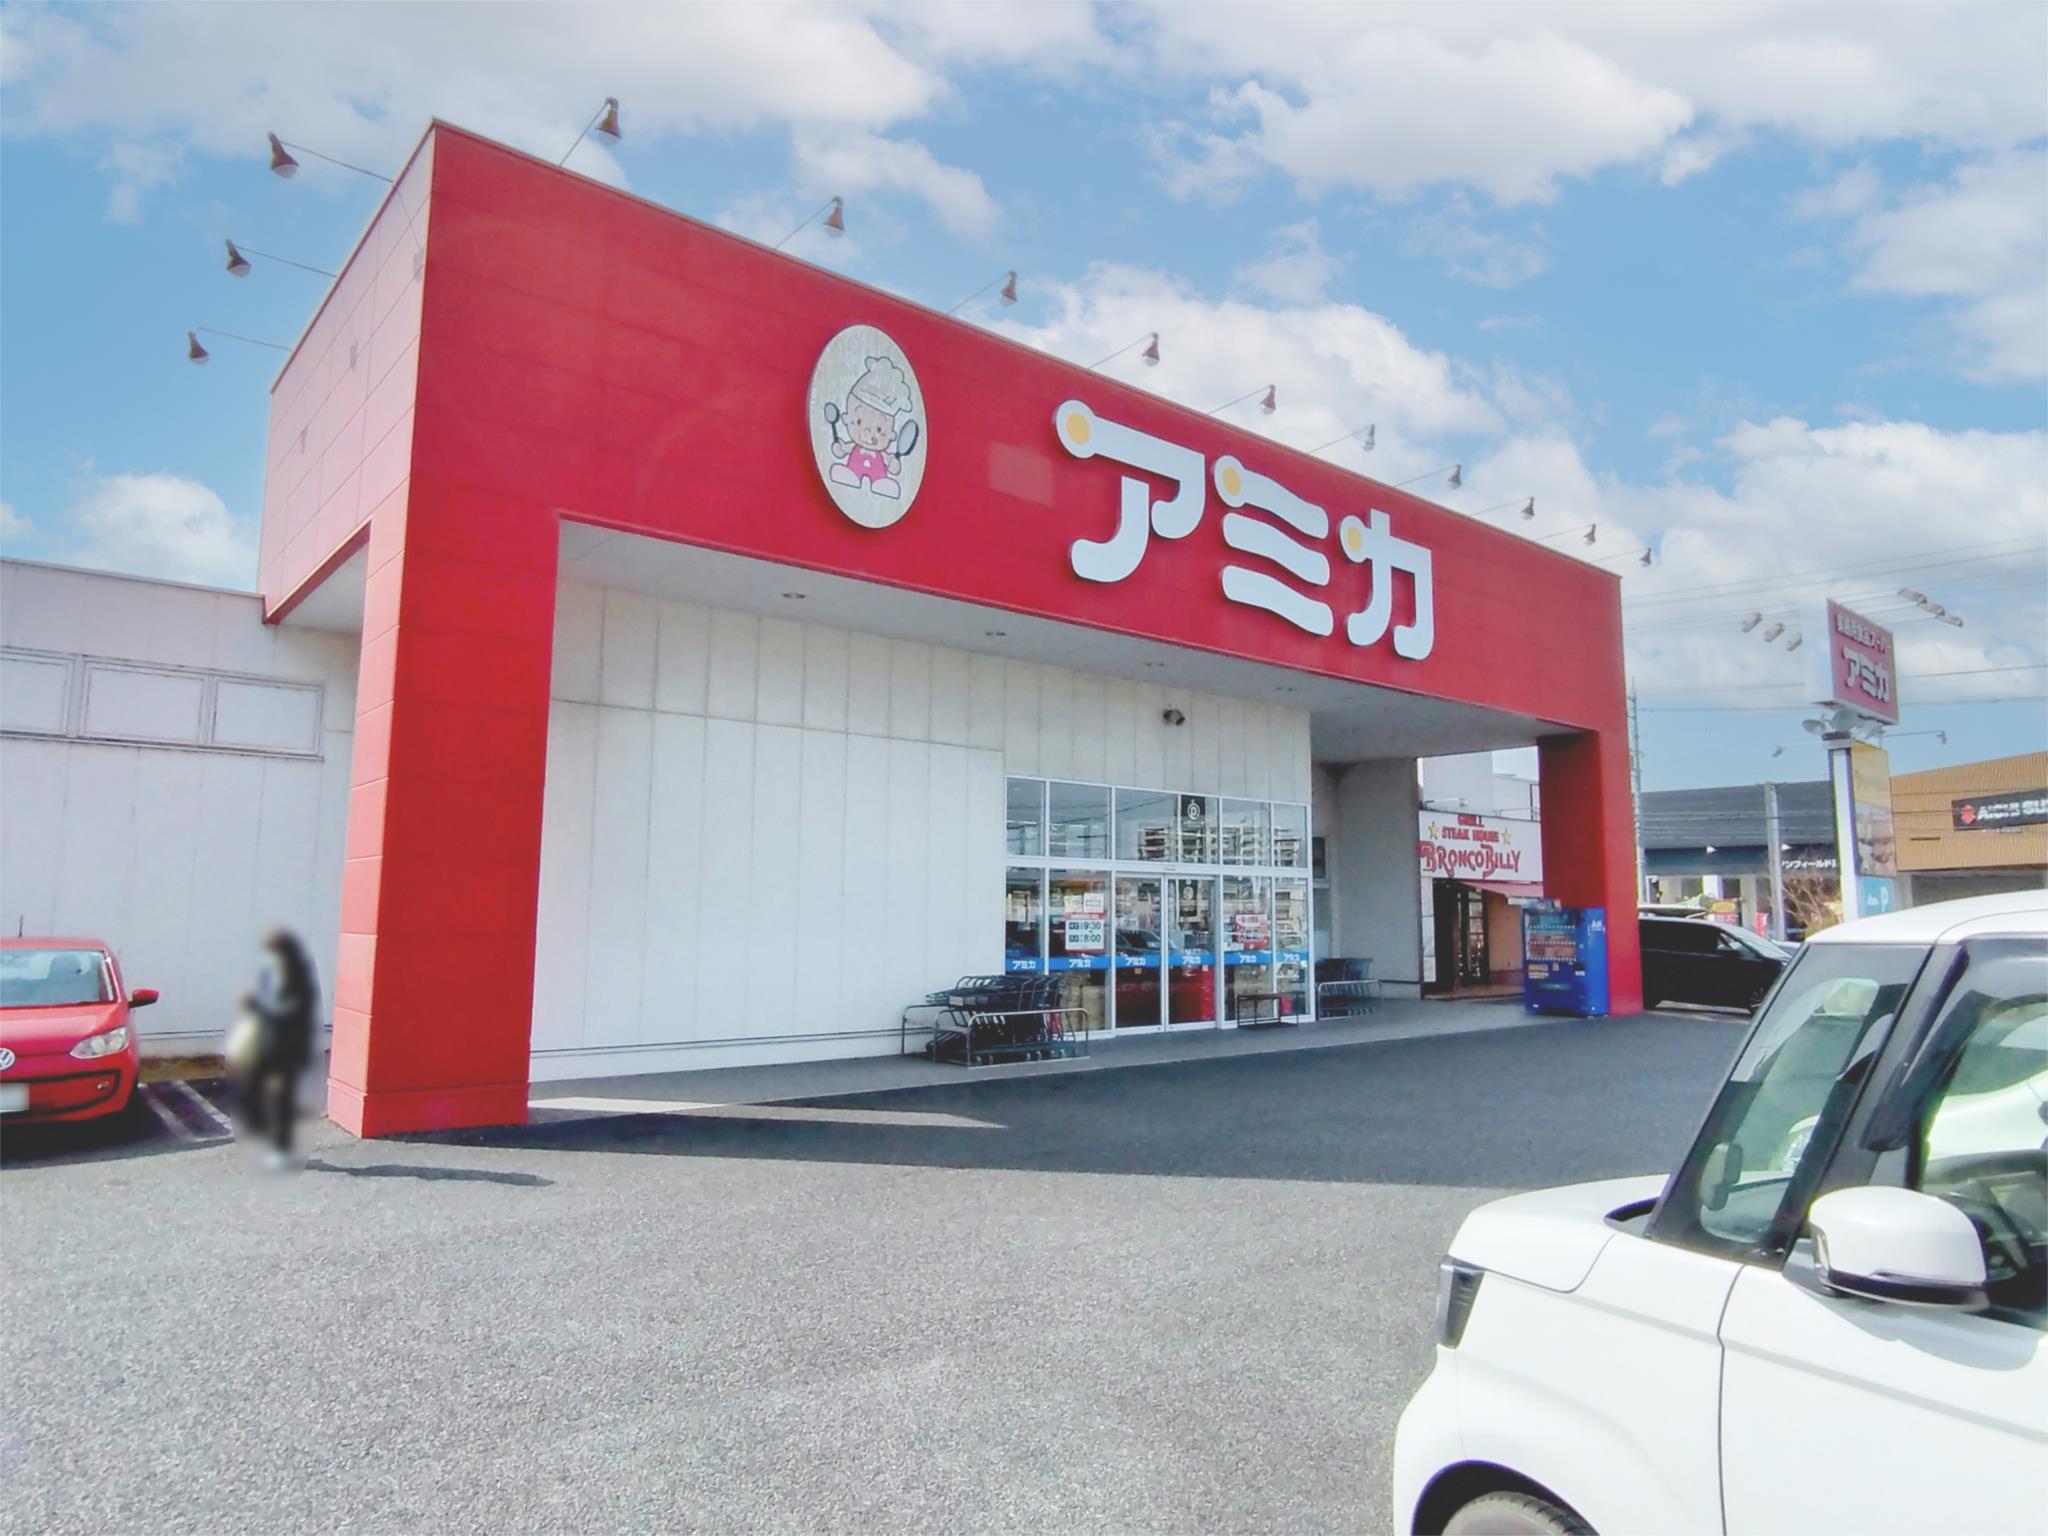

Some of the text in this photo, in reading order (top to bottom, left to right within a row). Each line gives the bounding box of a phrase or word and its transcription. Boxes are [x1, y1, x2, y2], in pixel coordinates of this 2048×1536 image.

[1055, 399, 1434, 660] アミカ
[1842, 646, 1890, 703] アミカ
[1442, 826, 1500, 843] STEAK HOUSE
[1012, 960, 1037, 970] アミカ
[1069, 958, 1091, 968] アミカ
[1125, 956, 1146, 966] アミカ
